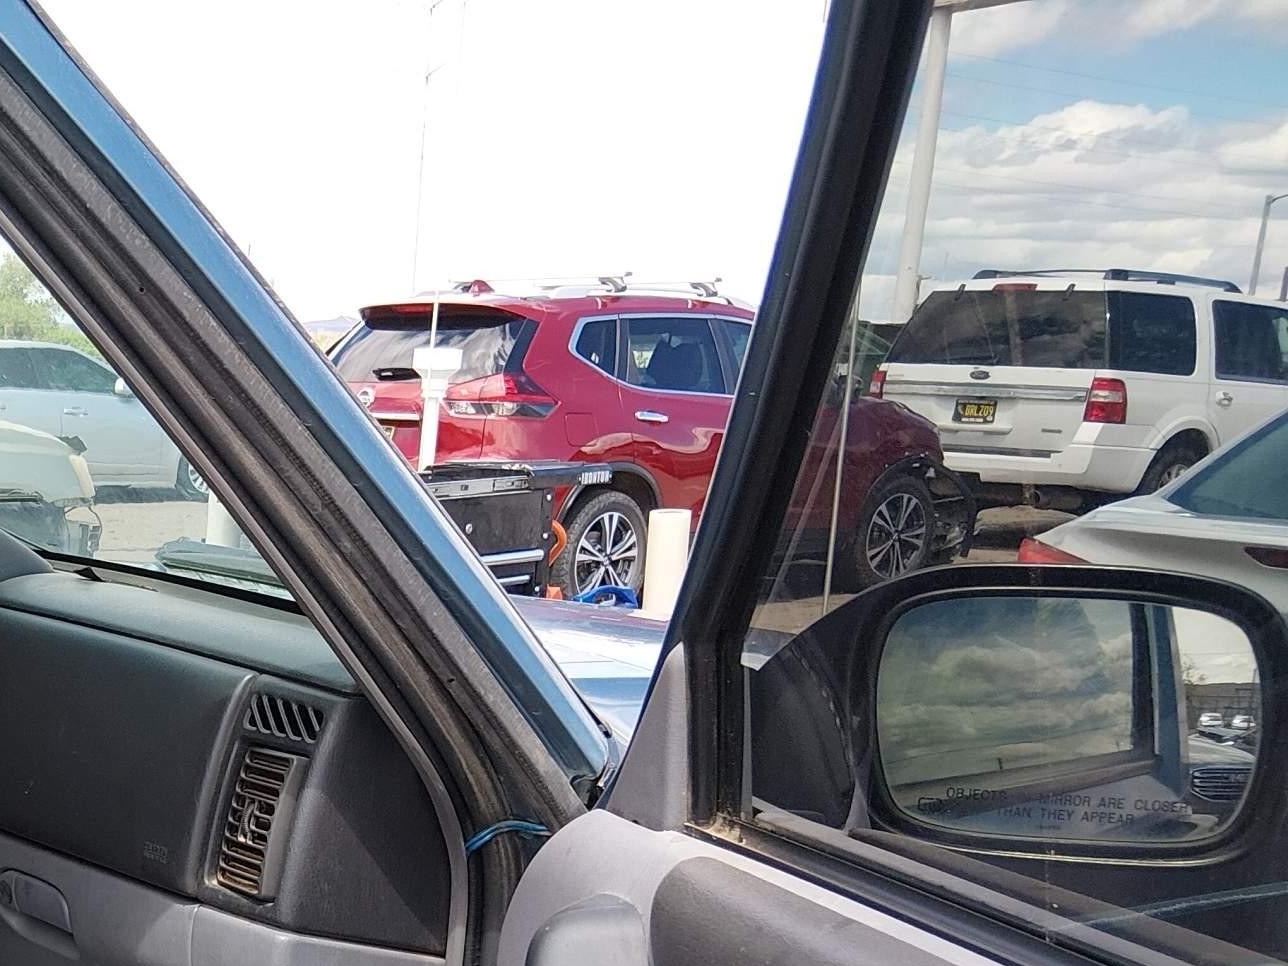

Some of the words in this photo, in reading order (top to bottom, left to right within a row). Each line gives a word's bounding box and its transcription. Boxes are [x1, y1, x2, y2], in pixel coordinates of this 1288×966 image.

[946, 787, 1007, 800] OBJECTS
[1038, 796, 1091, 807] MIRROR
[1098, 797, 1125, 809] ARE
[1134, 799, 1189, 814] CLOSER
[998, 808, 1031, 818] THAN
[1040, 810, 1073, 821] THEY
[1081, 812, 1134, 824] APPEAR
